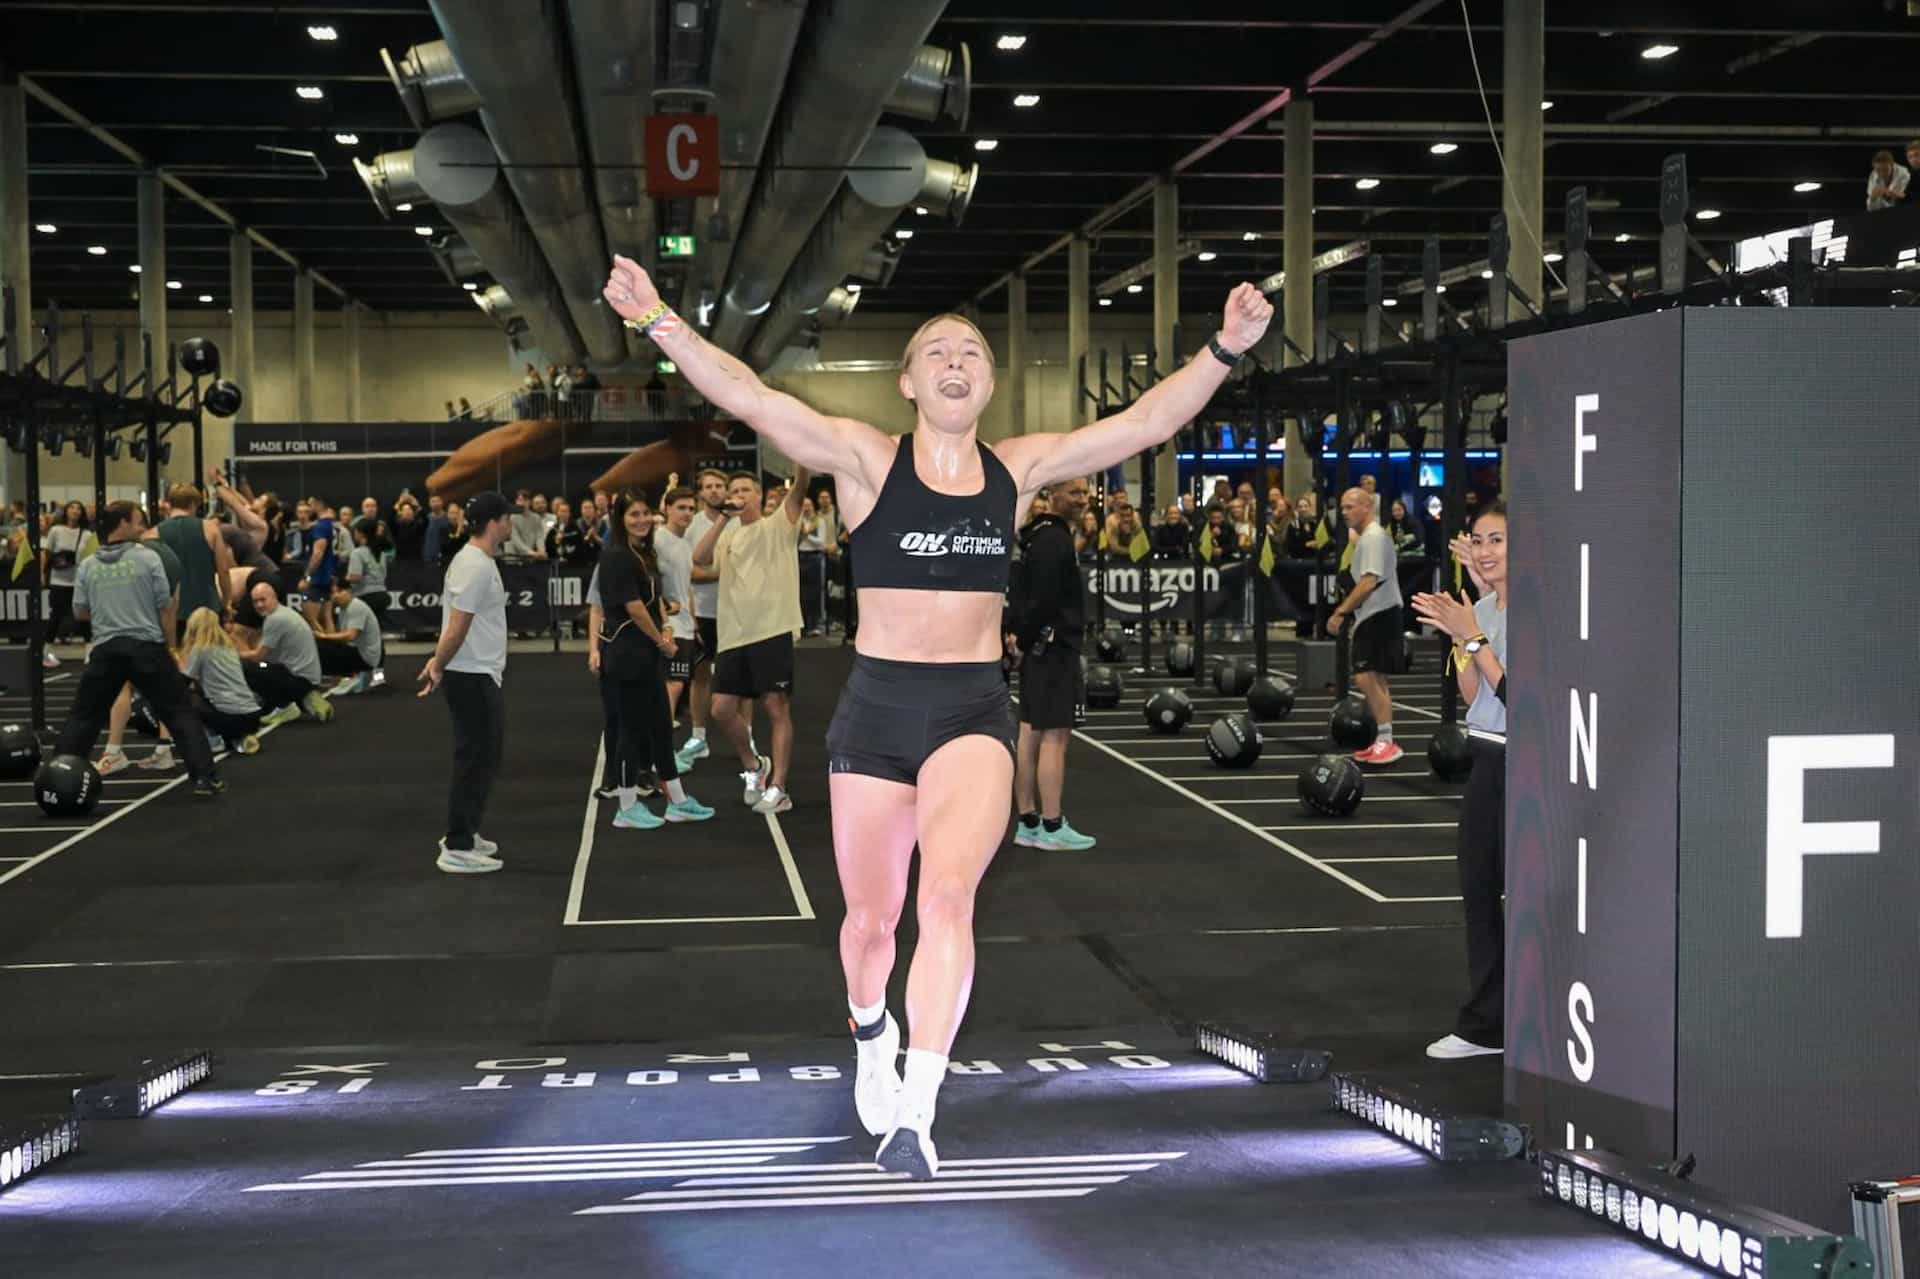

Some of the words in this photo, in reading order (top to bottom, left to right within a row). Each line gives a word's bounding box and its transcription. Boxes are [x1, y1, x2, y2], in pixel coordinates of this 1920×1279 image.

[666, 123, 698, 181] C
[250, 441, 282, 452] MADE
[285, 441, 309, 452] FOR
[310, 440, 337, 452] THIS
[900, 532, 947, 552] ON
[951, 544, 1006, 555] NUTRITION
[953, 535, 1002, 546] OPTIMUM
[1567, 394, 1600, 1150] FINIS
[1766, 734, 1894, 939] F
[279, 1040, 1137, 1076] HROX
[254, 1077, 374, 1096] IS
[460, 1065, 842, 1091] SPORT
